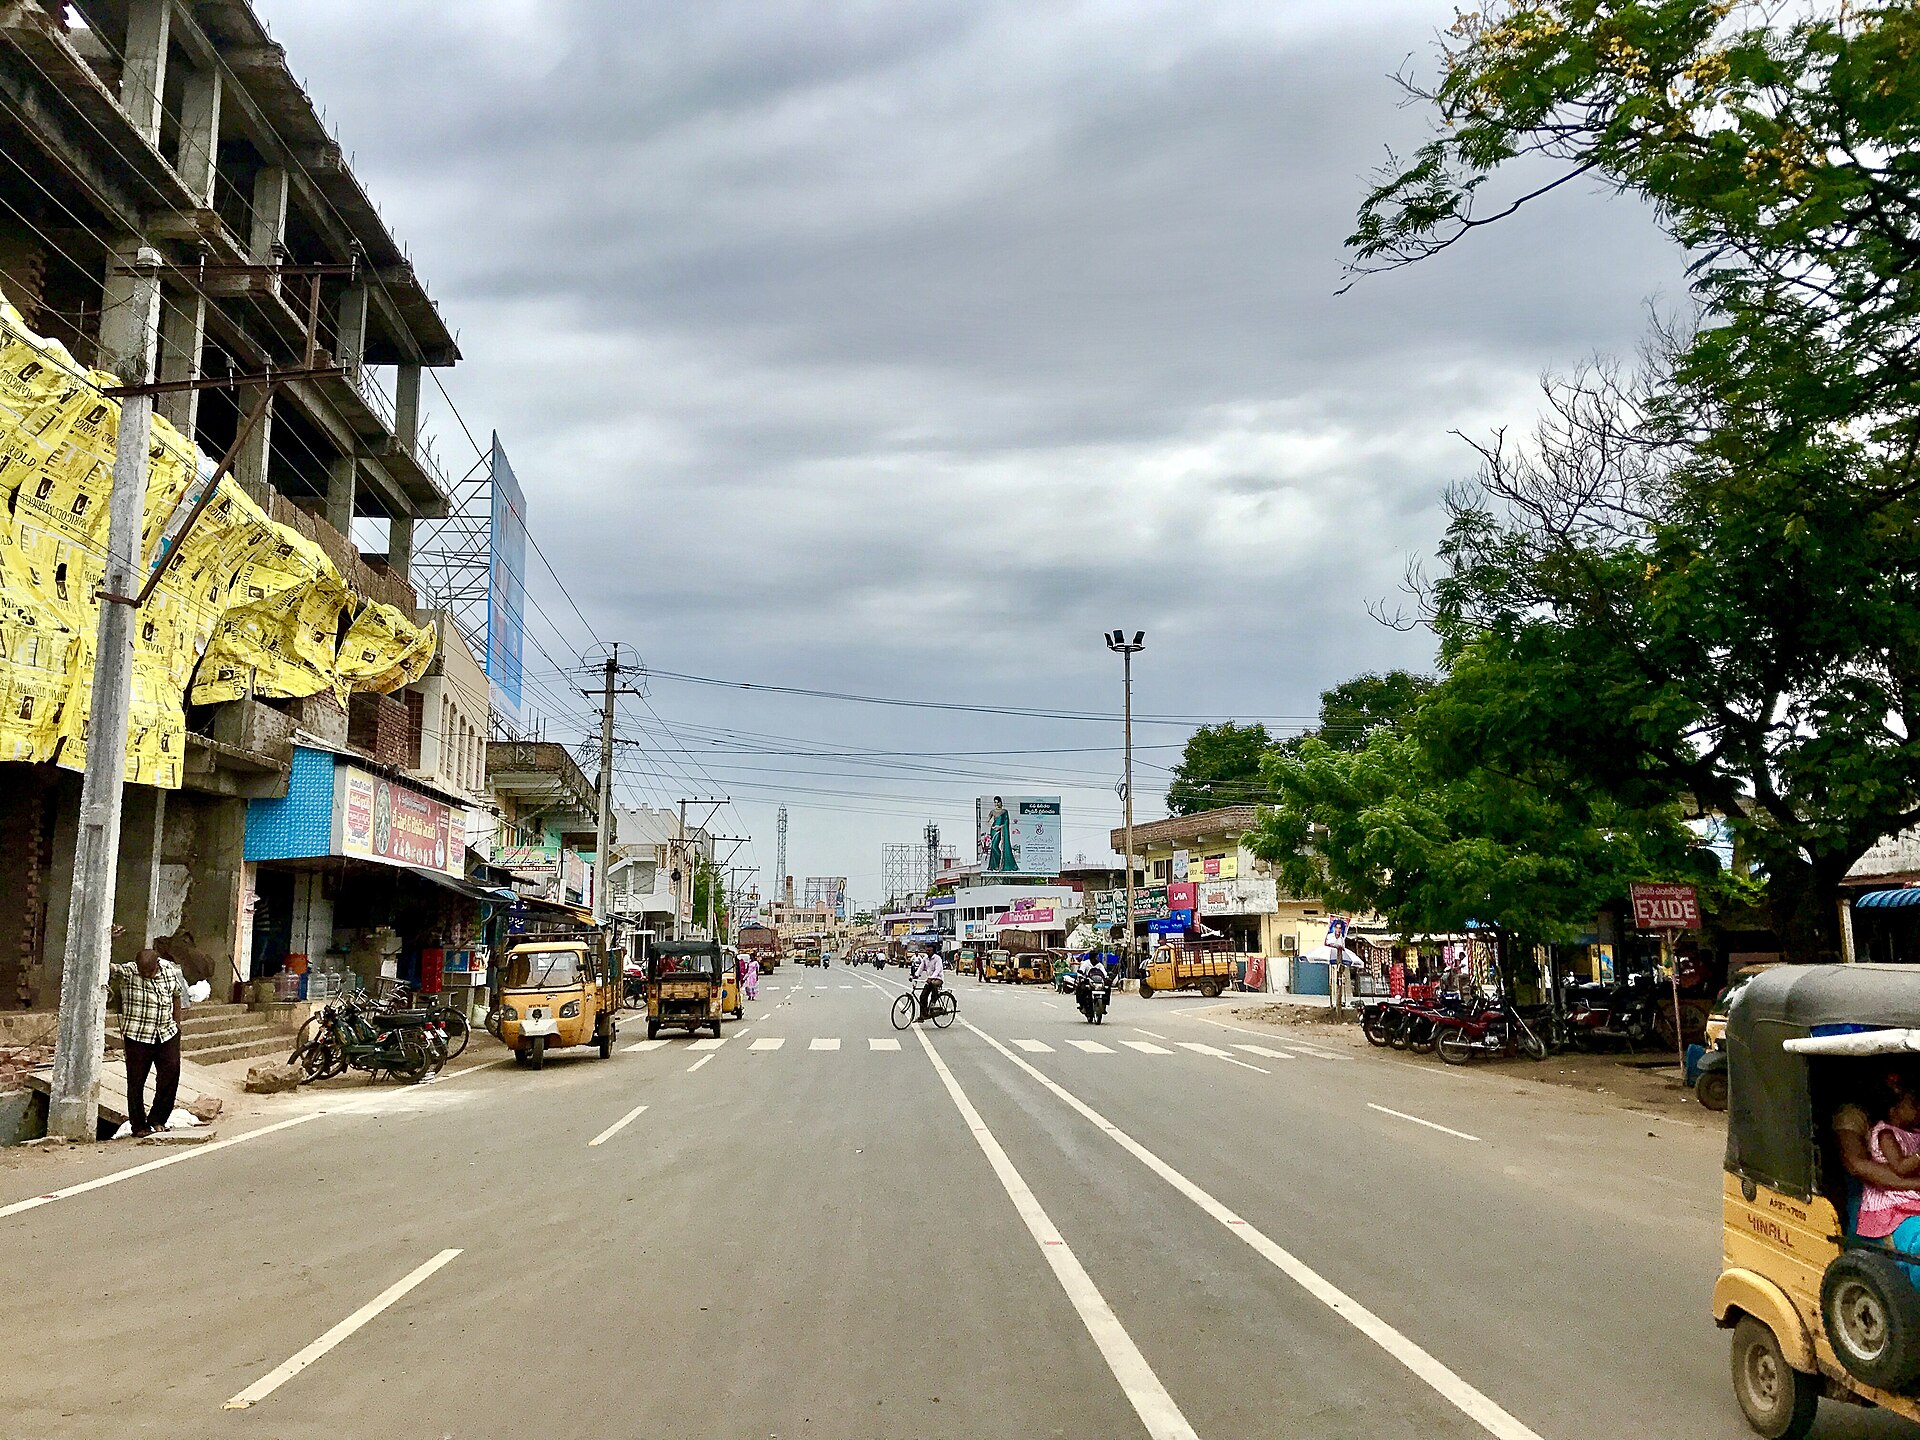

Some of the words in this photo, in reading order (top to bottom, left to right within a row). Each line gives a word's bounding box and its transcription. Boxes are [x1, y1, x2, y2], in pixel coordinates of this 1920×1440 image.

[1173, 892, 1188, 901] LAVA
[1636, 900, 1697, 919] EXIDE
[1009, 911, 1034, 922] Mahindra
